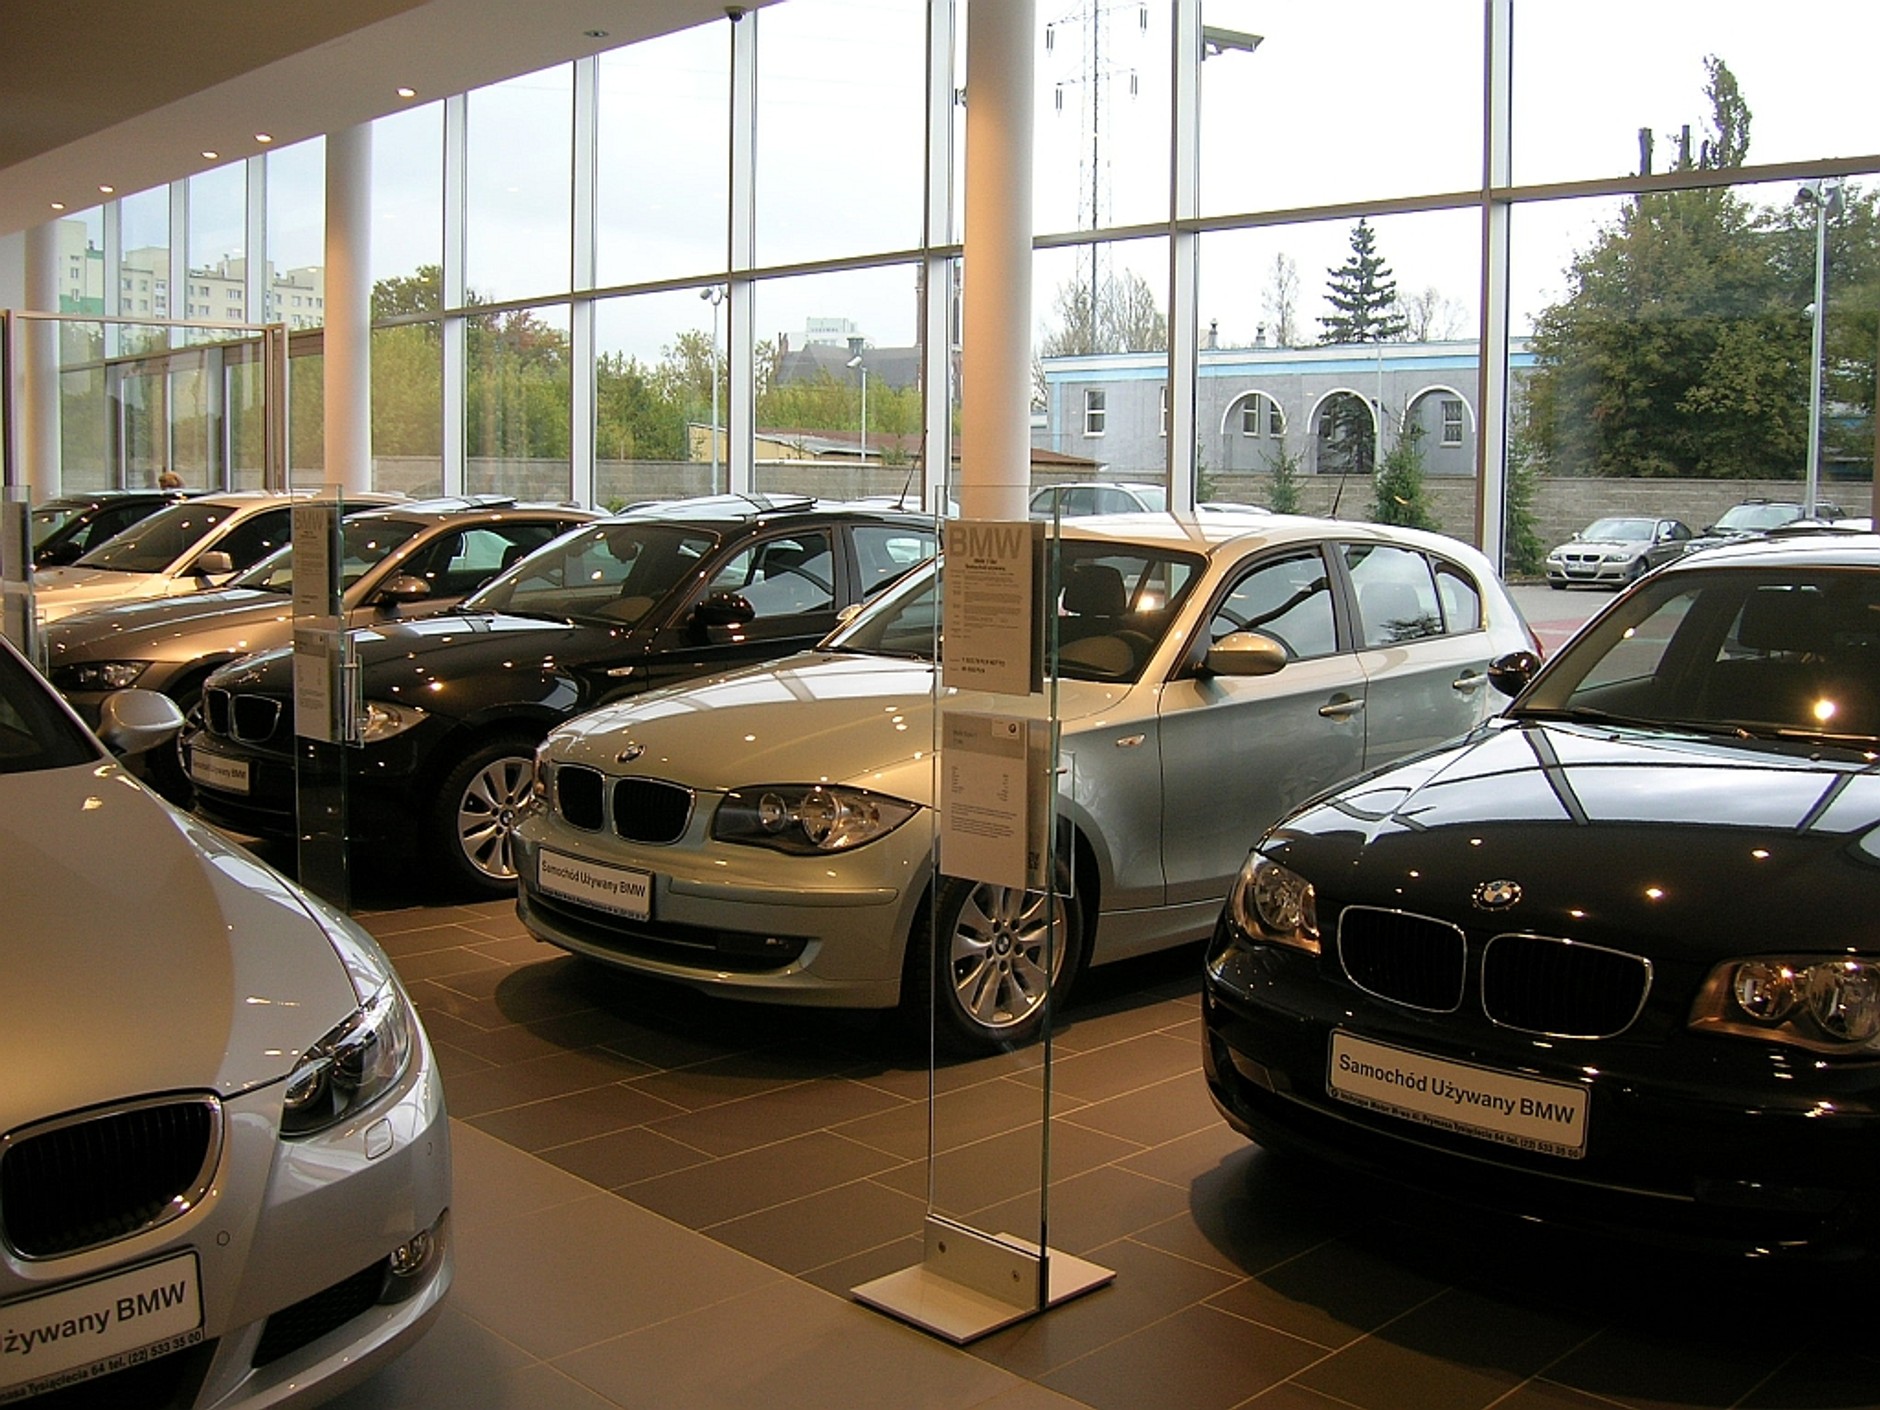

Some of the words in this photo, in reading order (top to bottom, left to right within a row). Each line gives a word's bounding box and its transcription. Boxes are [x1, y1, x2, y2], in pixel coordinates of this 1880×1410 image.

[948, 526, 1023, 559] BMW
[619, 881, 646, 897] BMW
[1339, 1053, 1428, 1093] Samochód
[1431, 1077, 1516, 1116] Używany
[1520, 1097, 1575, 1125] BMW
[0, 1309, 110, 1355] żywany
[117, 1280, 186, 1323] BMW
[91, 1362, 105, 1376] 64
[108, 1357, 126, 1370] tel.
[128, 1347, 148, 1366] (22)
[151, 1342, 170, 1357] 533
[172, 1336, 185, 1349] 35
[187, 1330, 201, 1343] 00
